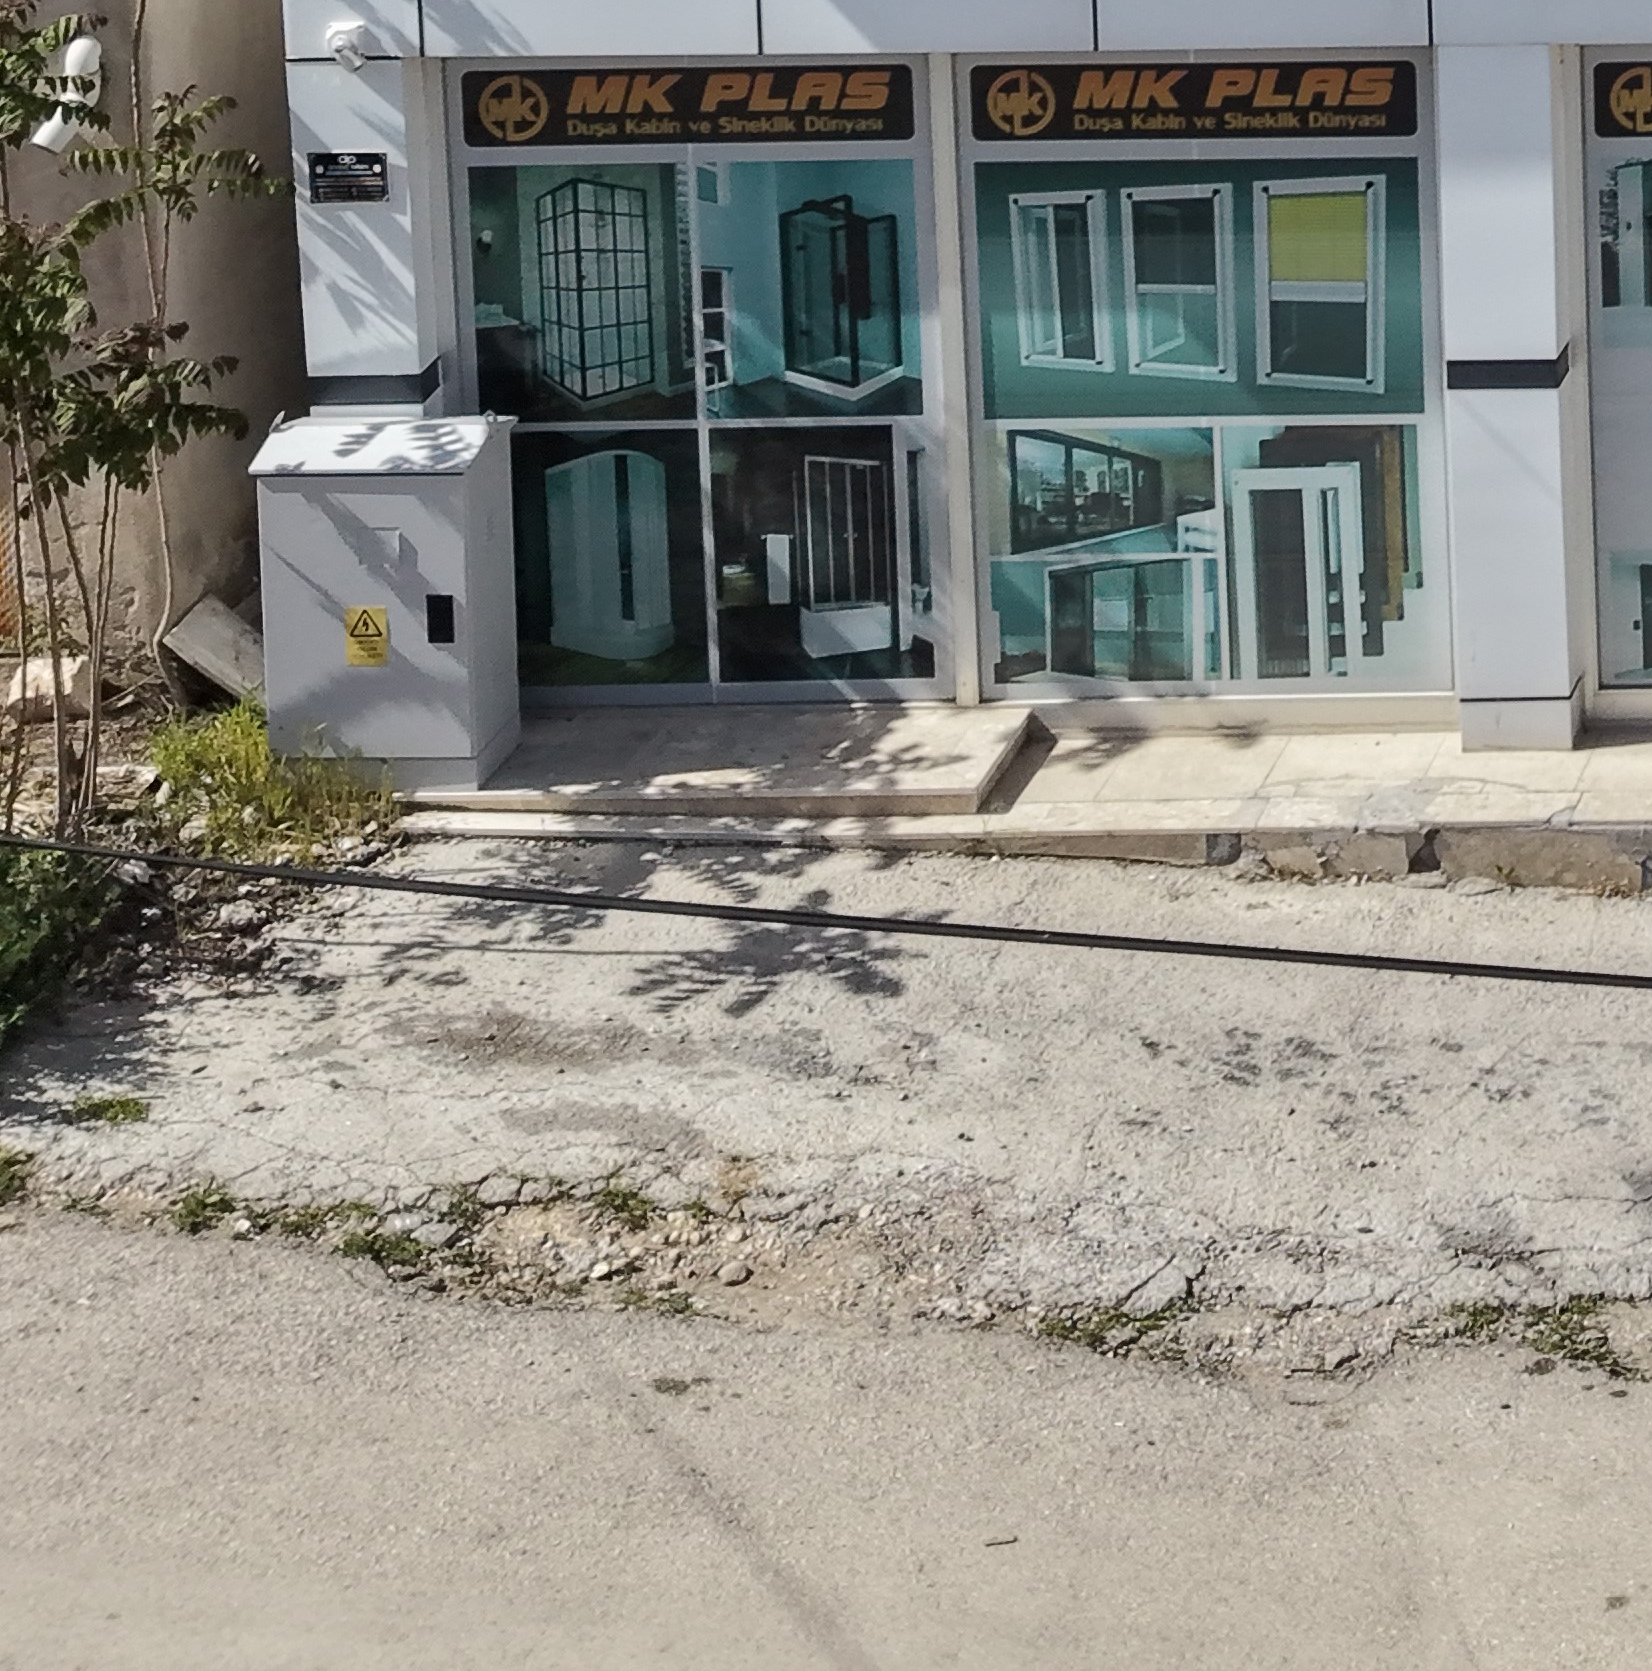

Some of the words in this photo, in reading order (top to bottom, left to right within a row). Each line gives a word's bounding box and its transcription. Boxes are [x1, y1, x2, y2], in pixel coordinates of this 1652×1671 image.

[566, 73, 685, 114] MK
[700, 71, 892, 112] PLAS
[1072, 69, 1189, 109] MK
[1204, 66, 1397, 108] PLAS
[626, 117, 681, 135] Kabin
[689, 121, 711, 134] ve
[720, 115, 797, 134] Sineklik
[1130, 111, 1186, 129] Kabin
[1193, 116, 1217, 129] ve
[1224, 111, 1301, 129] Sineklik
